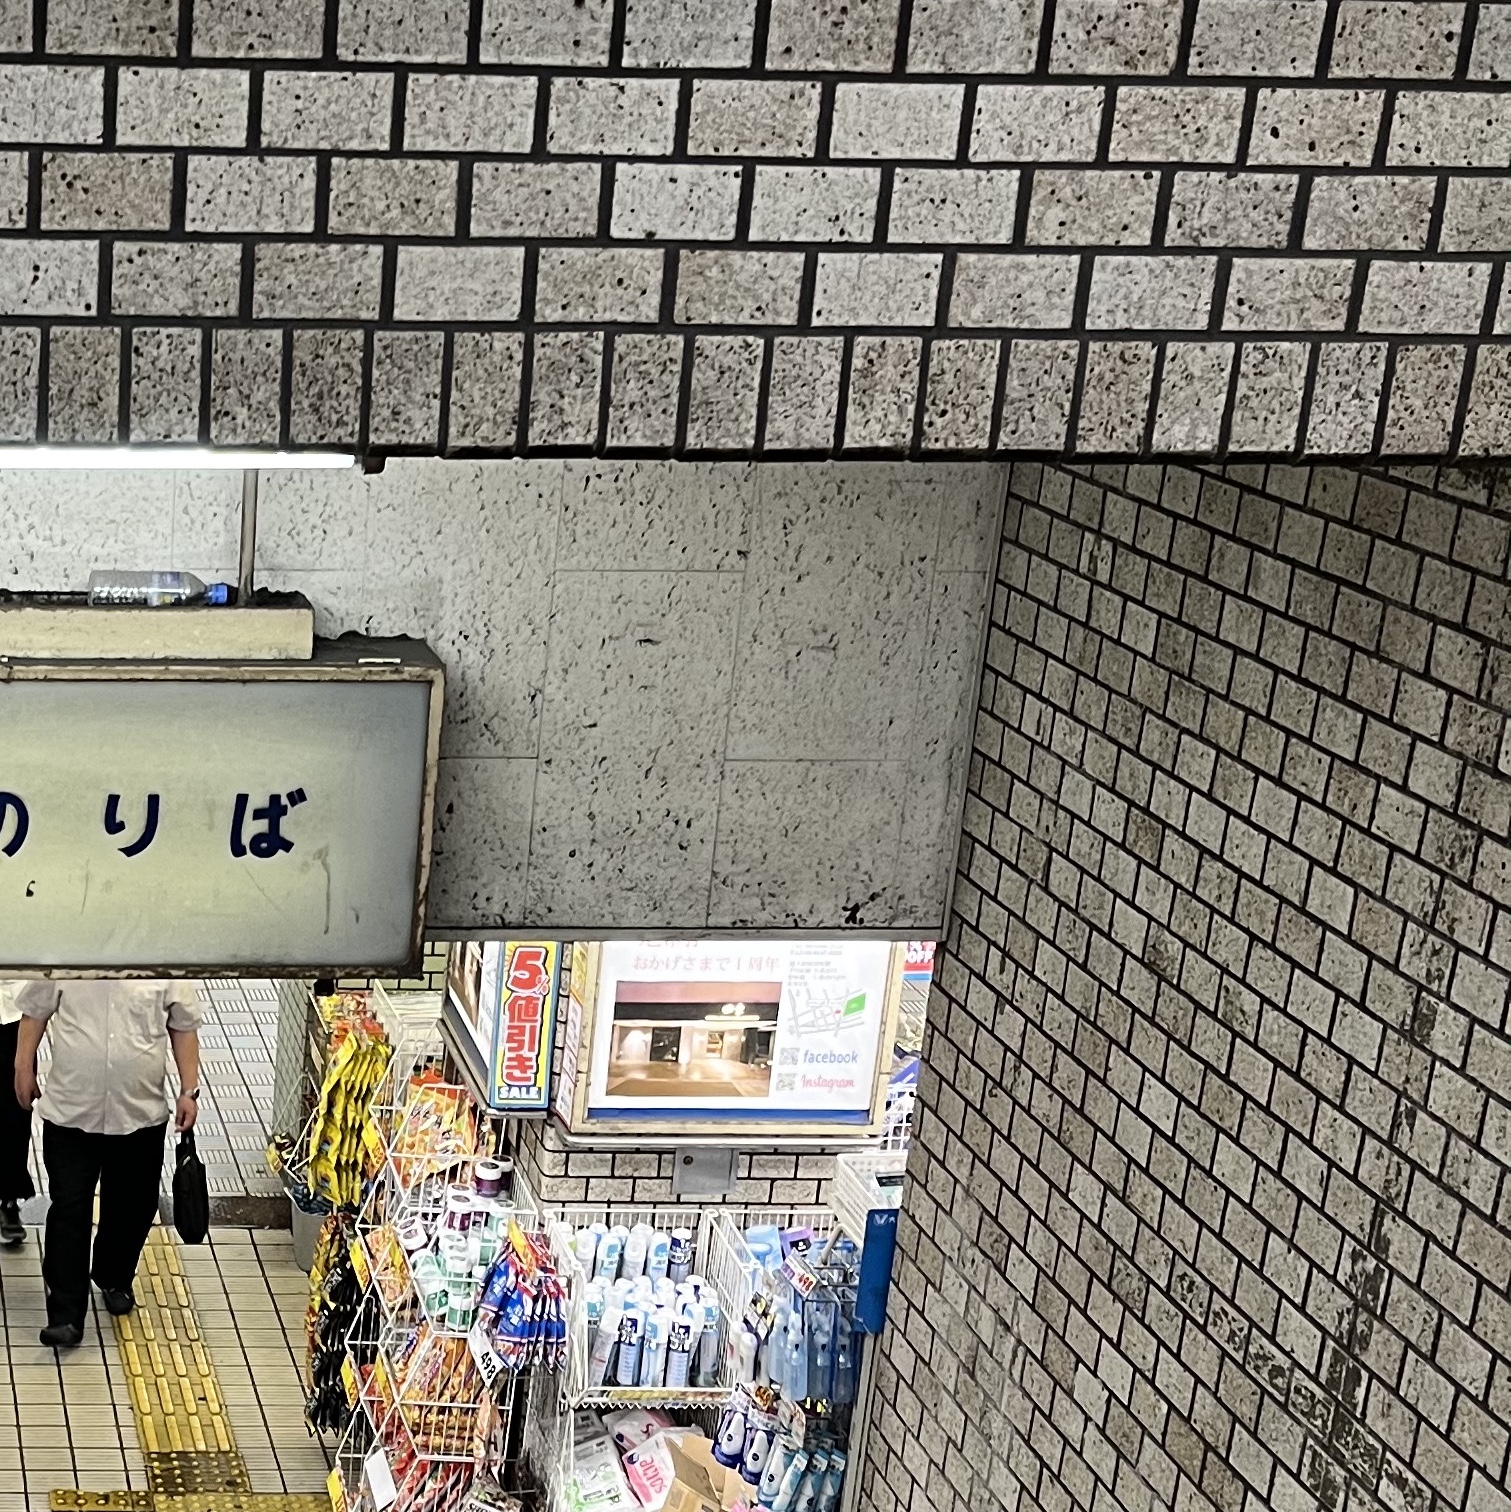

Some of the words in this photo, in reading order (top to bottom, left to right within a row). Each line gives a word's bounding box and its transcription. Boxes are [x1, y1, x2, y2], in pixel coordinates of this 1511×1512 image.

[503, 947, 551, 1085] 5%値引き
[802, 1049, 859, 1065] facebook
[499, 1086, 539, 1099] SALE
[800, 1072, 856, 1093] Instagram
[480, 1351, 497, 1380] 498
